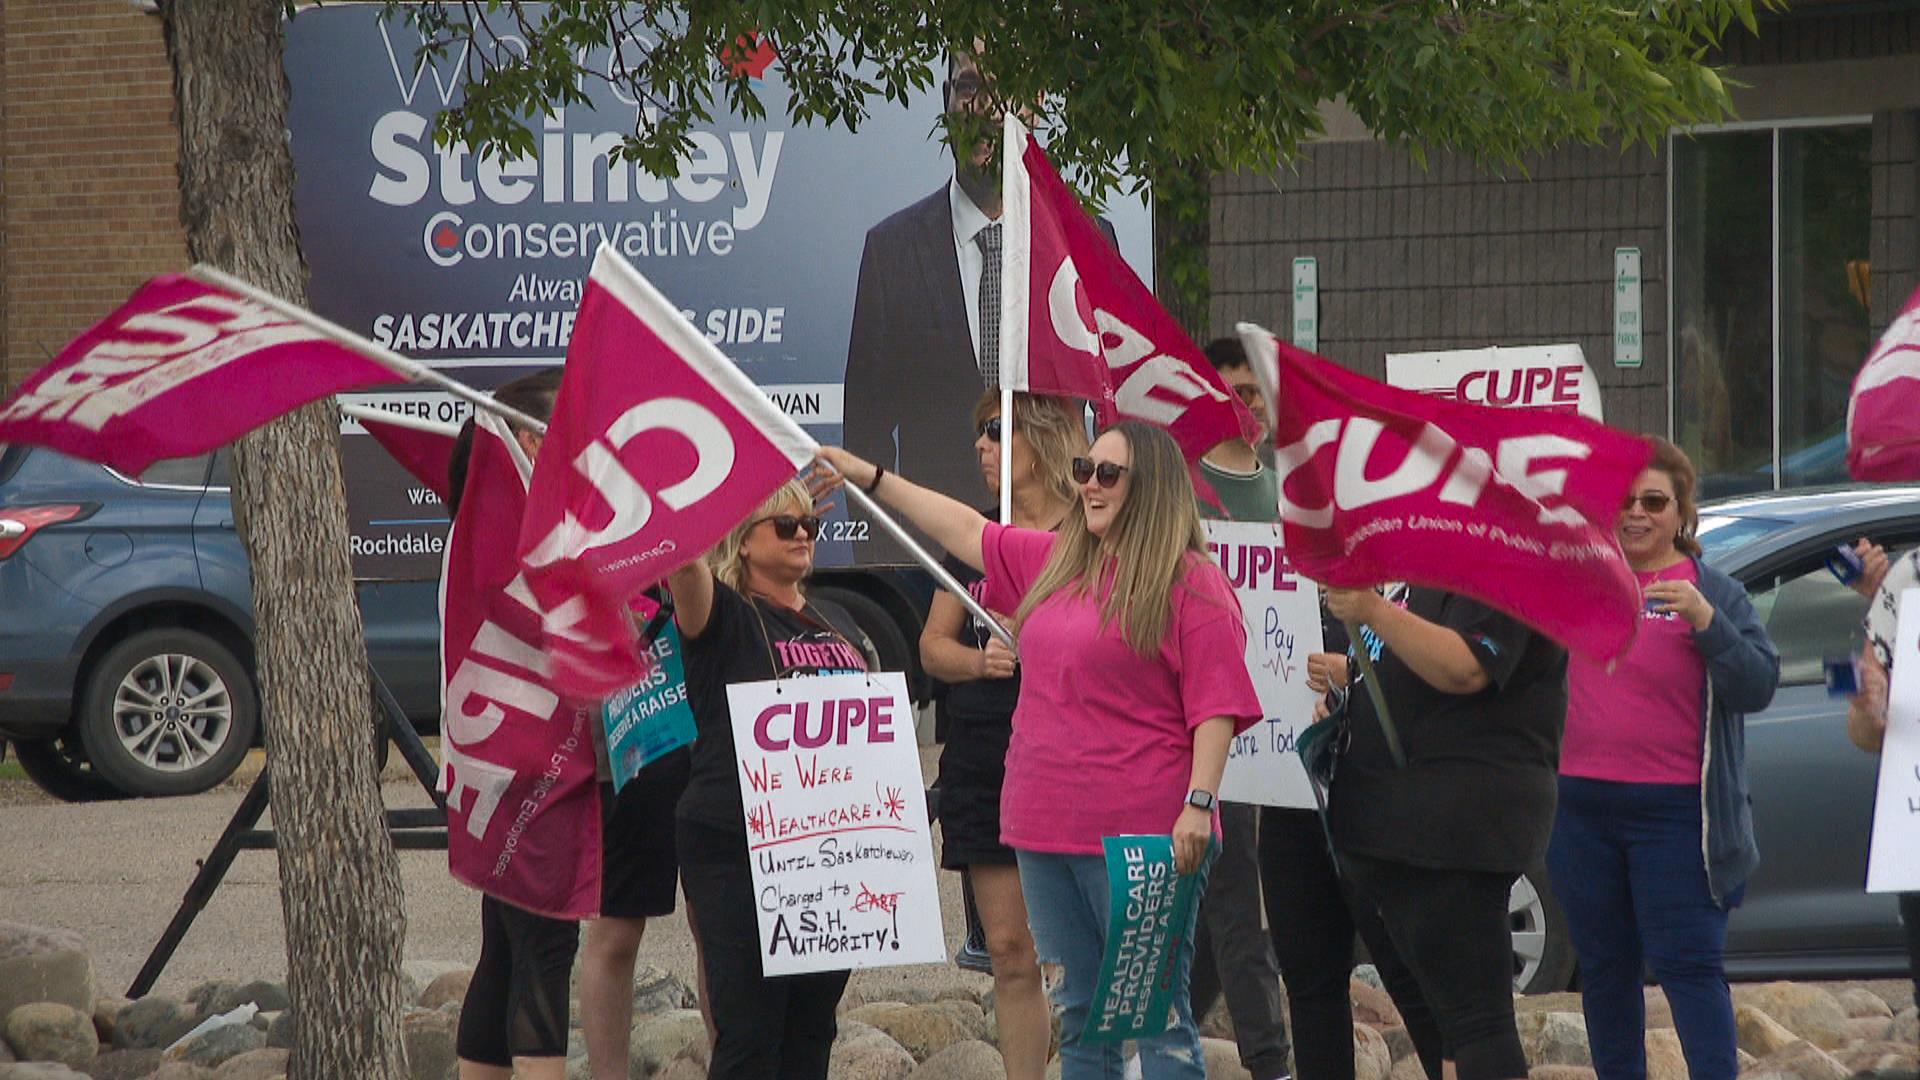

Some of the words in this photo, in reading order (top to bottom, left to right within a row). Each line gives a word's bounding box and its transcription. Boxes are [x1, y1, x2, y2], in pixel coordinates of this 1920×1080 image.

[423, 210, 735, 267] Conservative
[508, 273, 583, 308] Alway
[704, 307, 784, 343] SIDE
[1456, 364, 1583, 405] CUPE
[437, 401, 466, 422] OF
[350, 534, 443, 554] Rochdale
[833, 521, 869, 542] 2Z2
[1408, 514, 1463, 533] Union
[1466, 522, 1487, 538] of
[1206, 542, 1298, 592] UPE
[1264, 606, 1294, 660] Pay
[640, 682, 688, 720] RAISE
[753, 695, 895, 753] CUPE
[828, 880, 850, 897] to
[1098, 928, 1138, 1031] HEALTH
[1124, 847, 1145, 922] CARE
[1119, 862, 1166, 1016] PROVIDERS
[1132, 934, 1166, 1030] DESERVE
[1159, 912, 1171, 928] A
